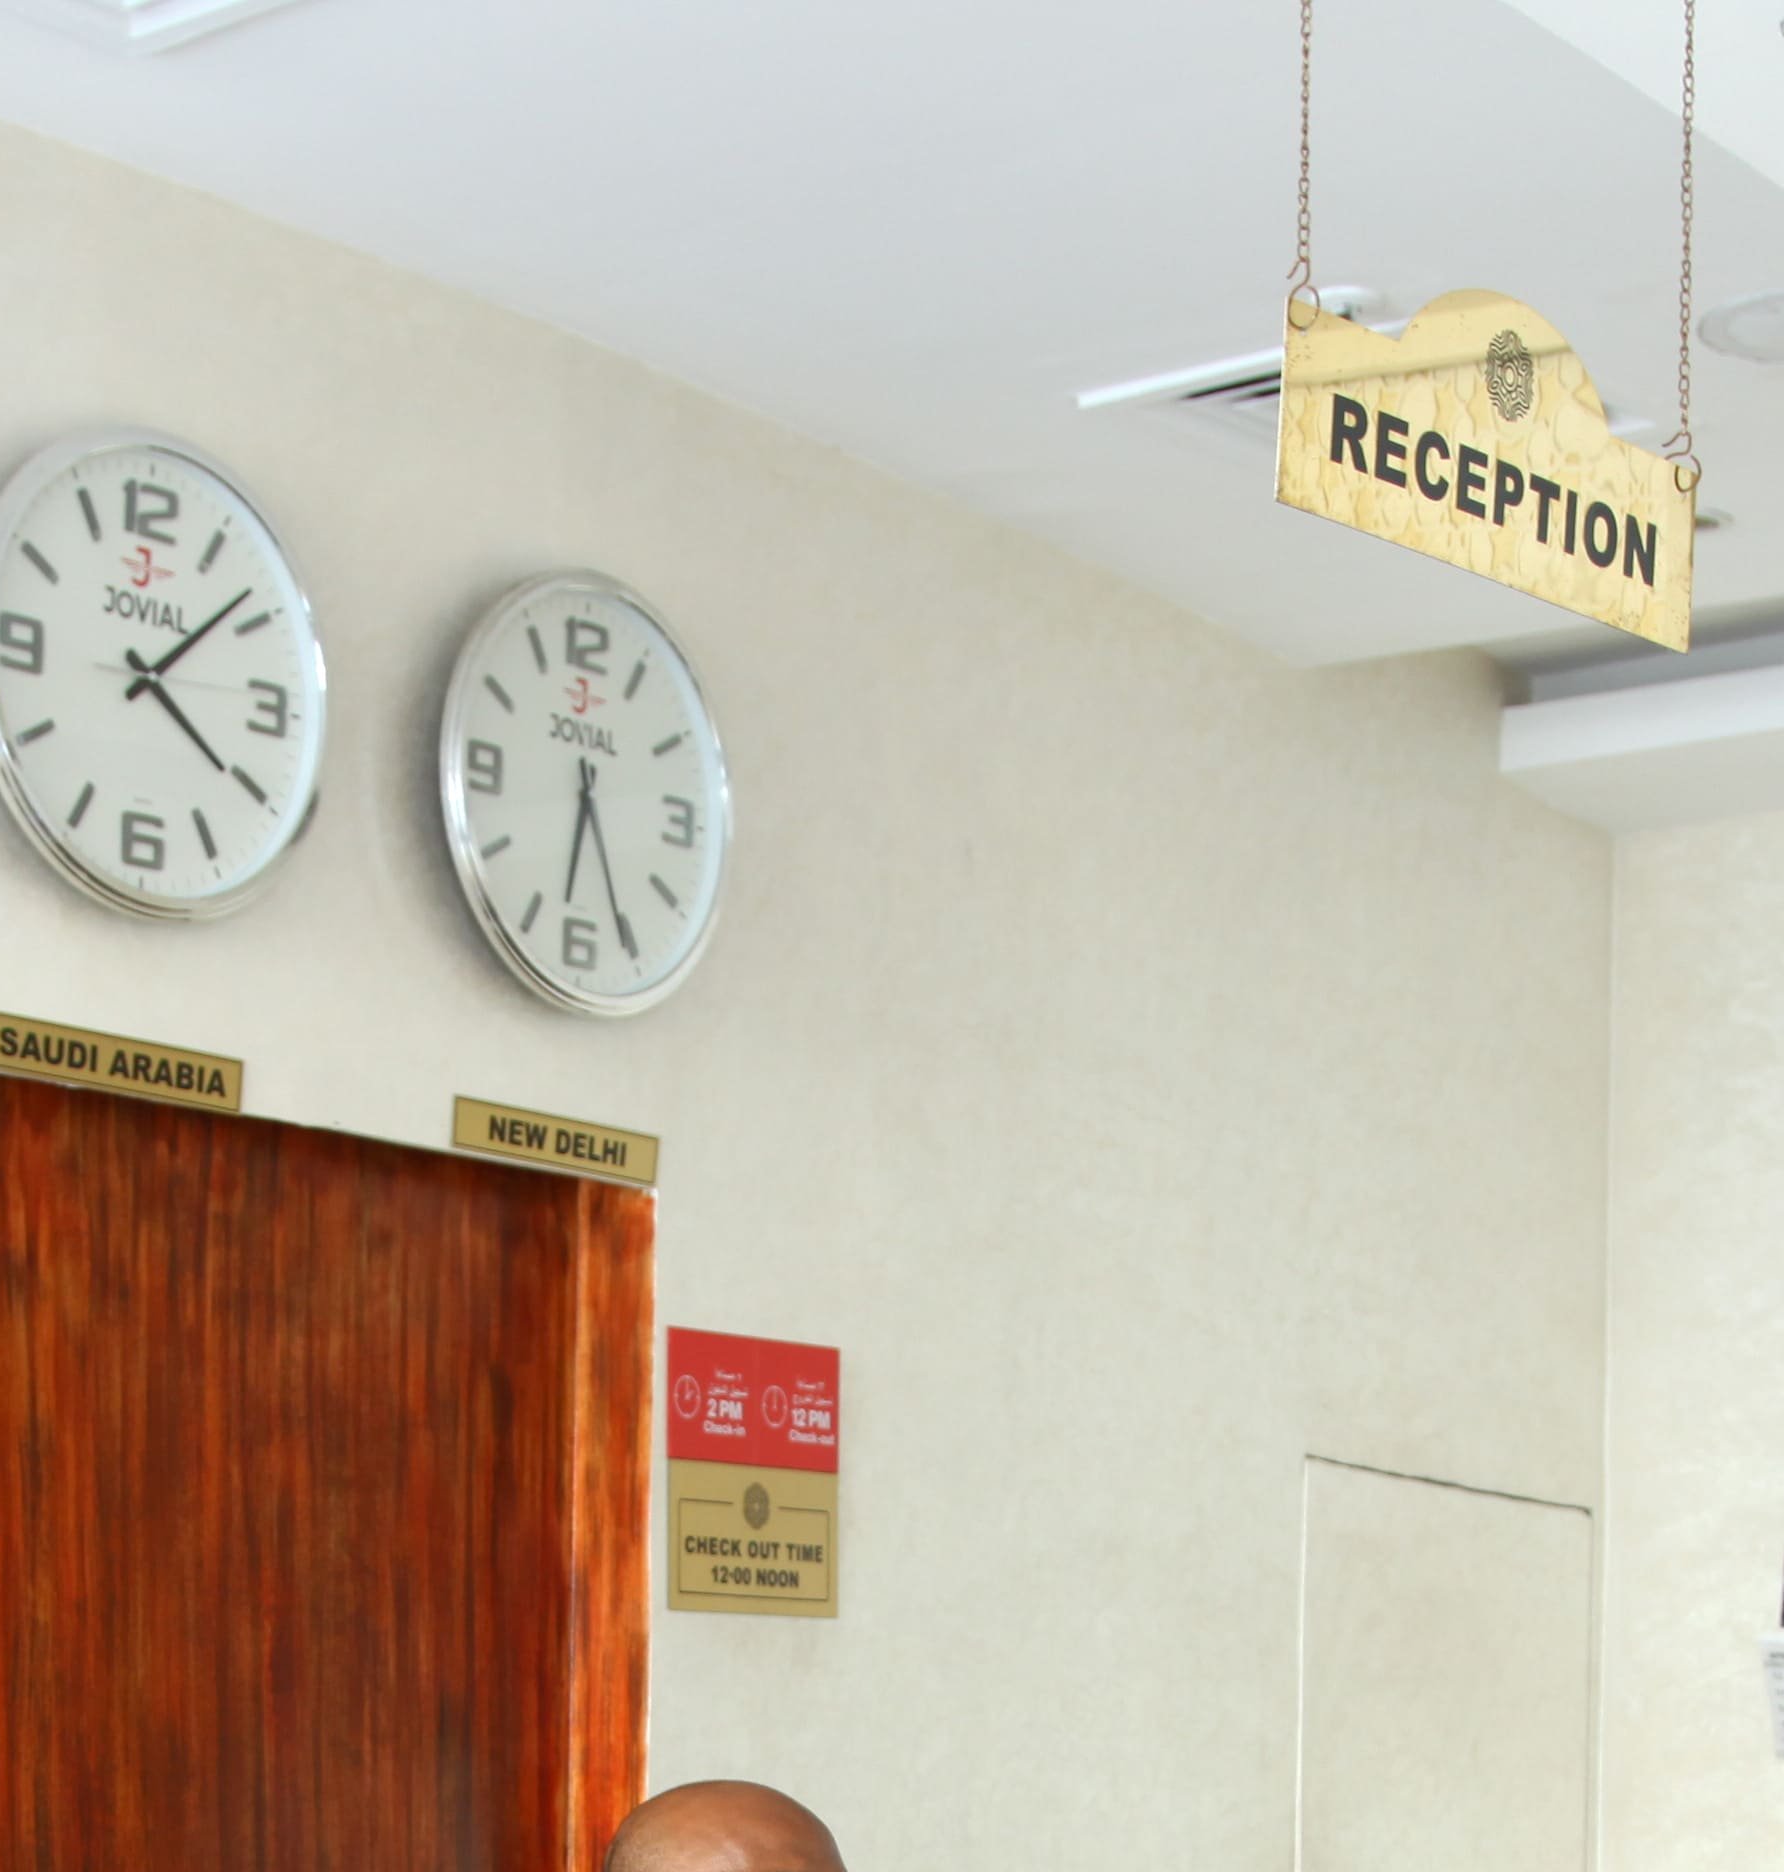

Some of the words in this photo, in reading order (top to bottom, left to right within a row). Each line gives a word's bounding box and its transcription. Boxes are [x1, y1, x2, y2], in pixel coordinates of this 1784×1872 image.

[124, 480, 178, 544] 12
[1328, 393, 1657, 588] RECEPTION
[103, 585, 189, 634] JOVIAL
[0, 614, 42, 673] 9
[566, 618, 608, 673] 12
[248, 680, 286, 737] 3
[550, 712, 618, 757] JOVIAL
[468, 740, 502, 794] 9
[122, 813, 163, 869] 6
[662, 796, 693, 848] 3
[563, 918, 596, 969] 6
[0, 1027, 97, 1072] SAUDI
[109, 1049, 226, 1098] ARABIA
[489, 1115, 547, 1149] NEW
[555, 1128, 627, 1166] DELHI
[707, 1398, 717, 1418] 2
[719, 1399, 743, 1420] PM
[791, 1407, 806, 1428] 12
[808, 1409, 831, 1430] PM
[684, 1535, 741, 1557] CHECK
[748, 1541, 780, 1559] OUT
[786, 1543, 824, 1563] TIME
[756, 1569, 799, 1588] NOON
